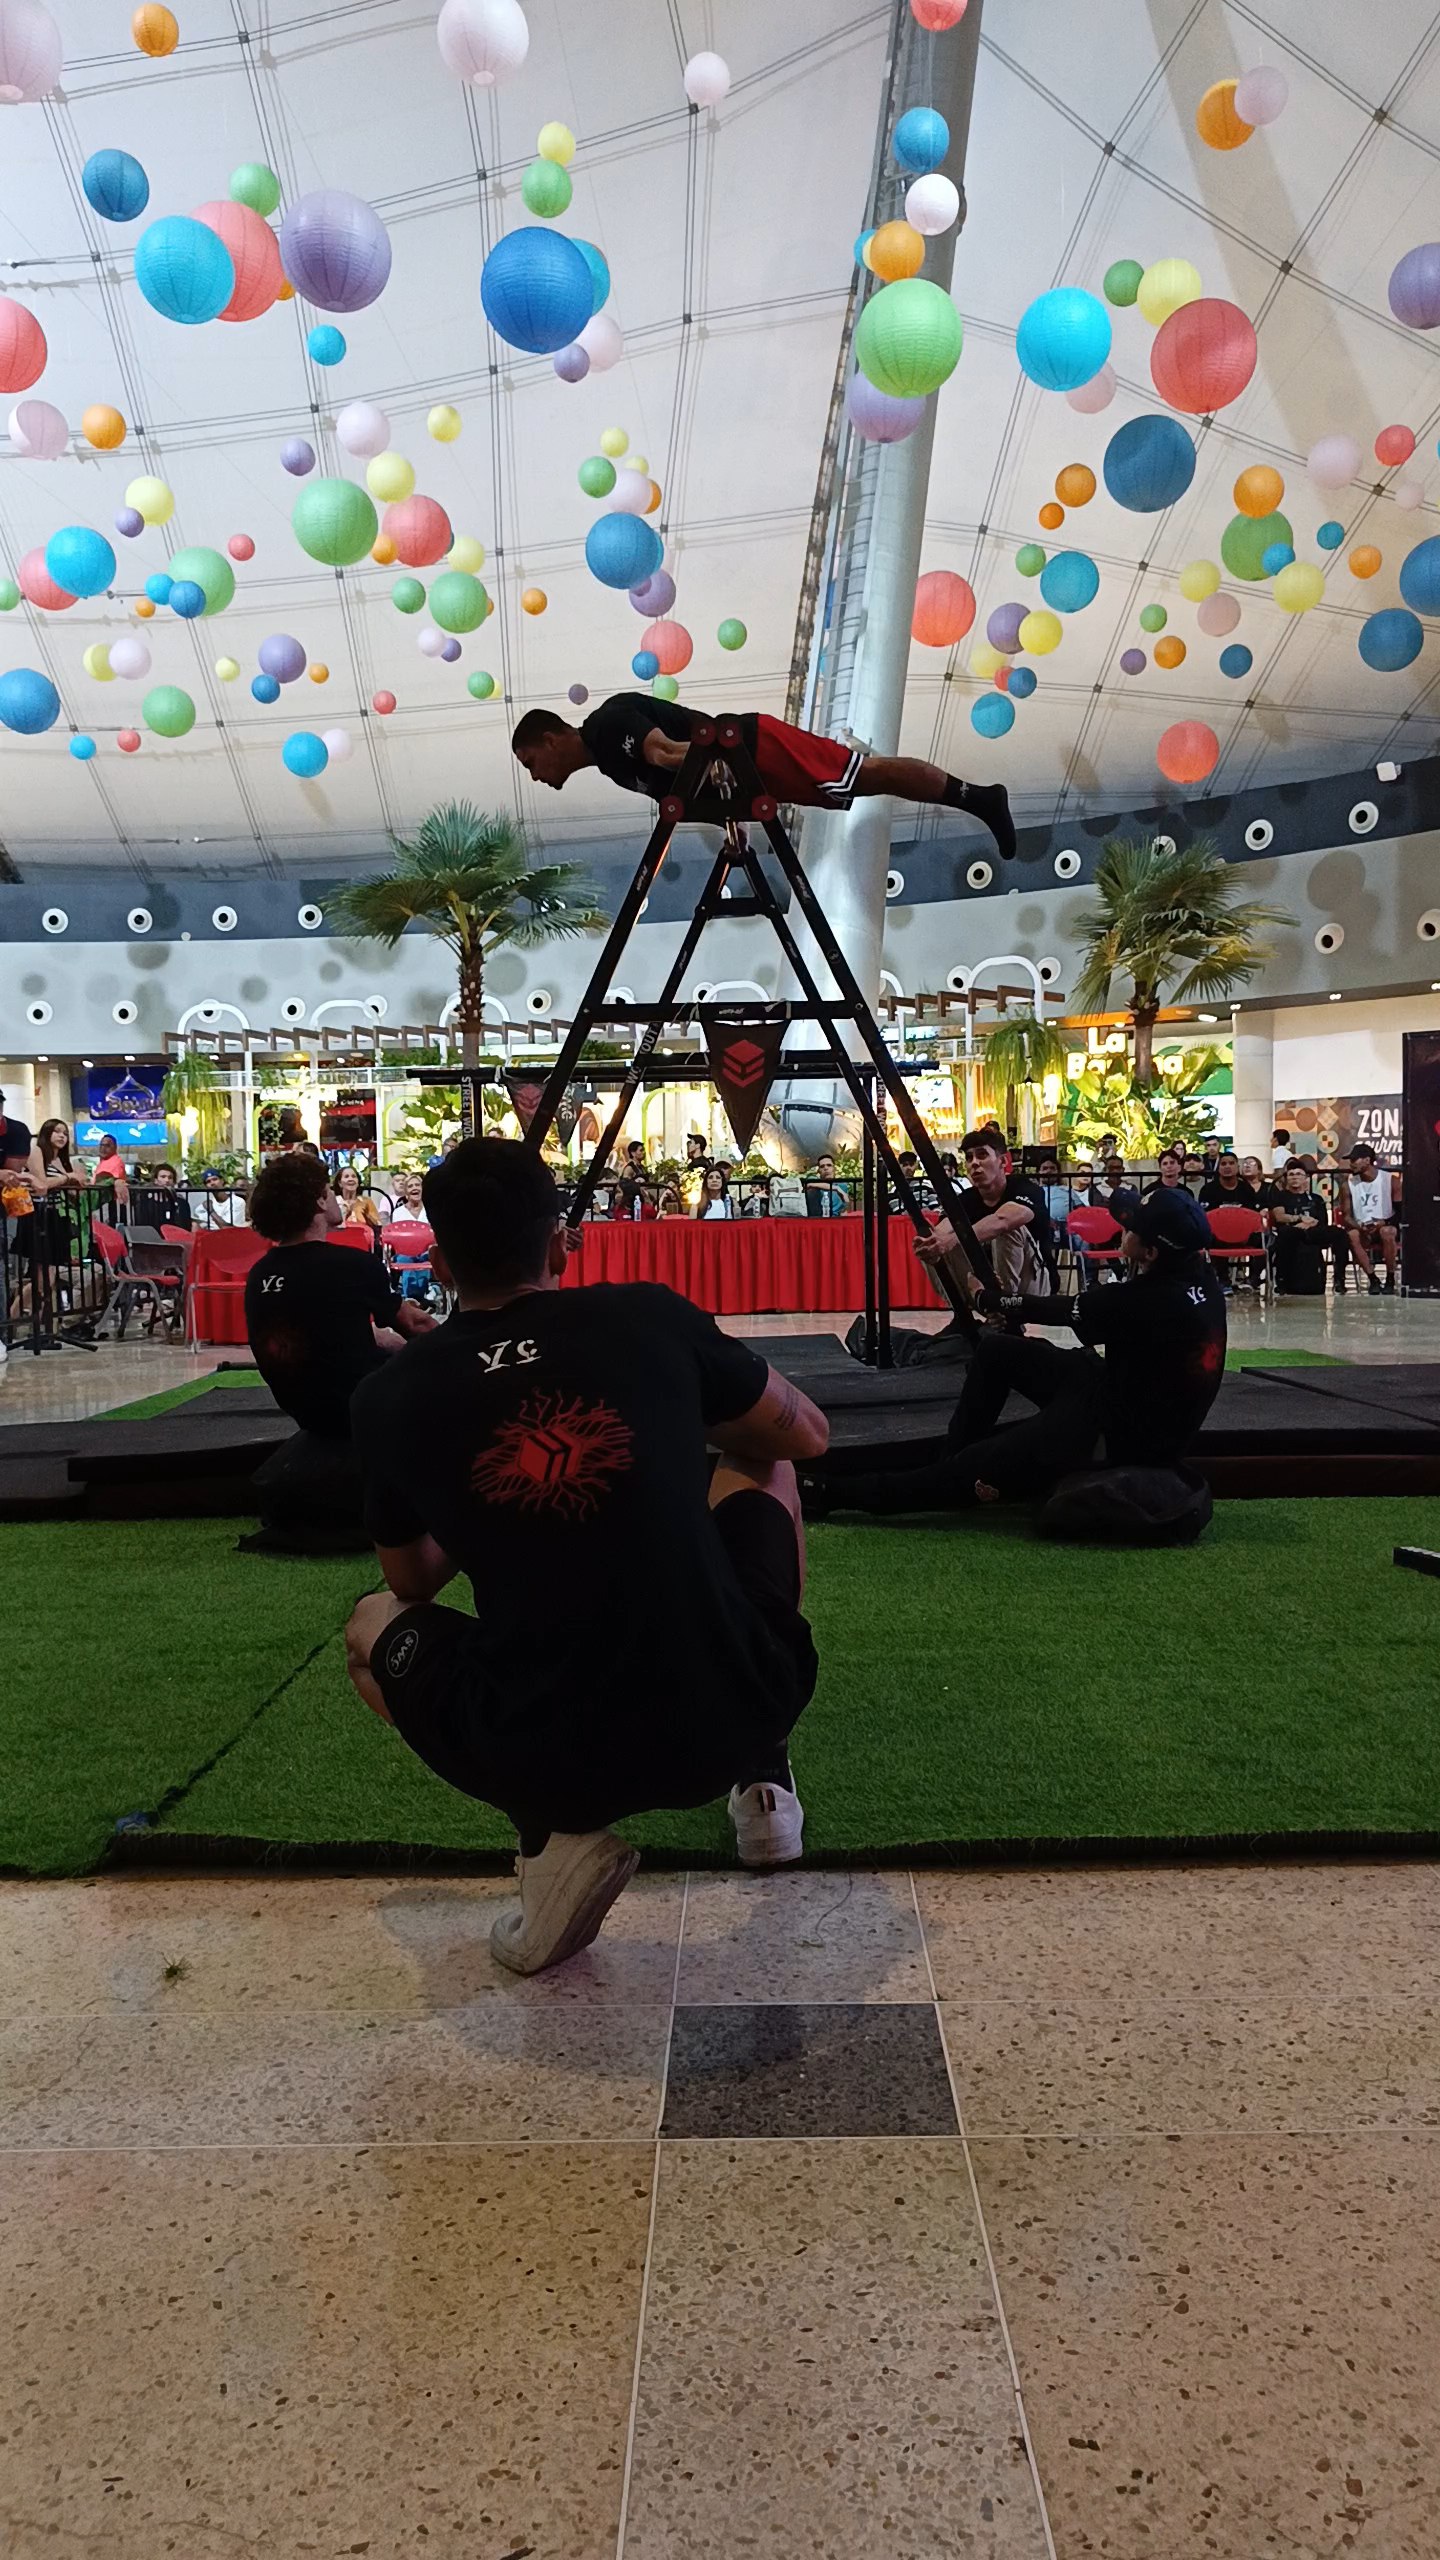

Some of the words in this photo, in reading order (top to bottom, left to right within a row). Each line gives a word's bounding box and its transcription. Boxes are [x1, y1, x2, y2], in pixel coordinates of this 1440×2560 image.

[1087, 1027, 1126, 1054] La
[461, 1076, 472, 1113] STREET
[1357, 1108, 1403, 1138] ZON
